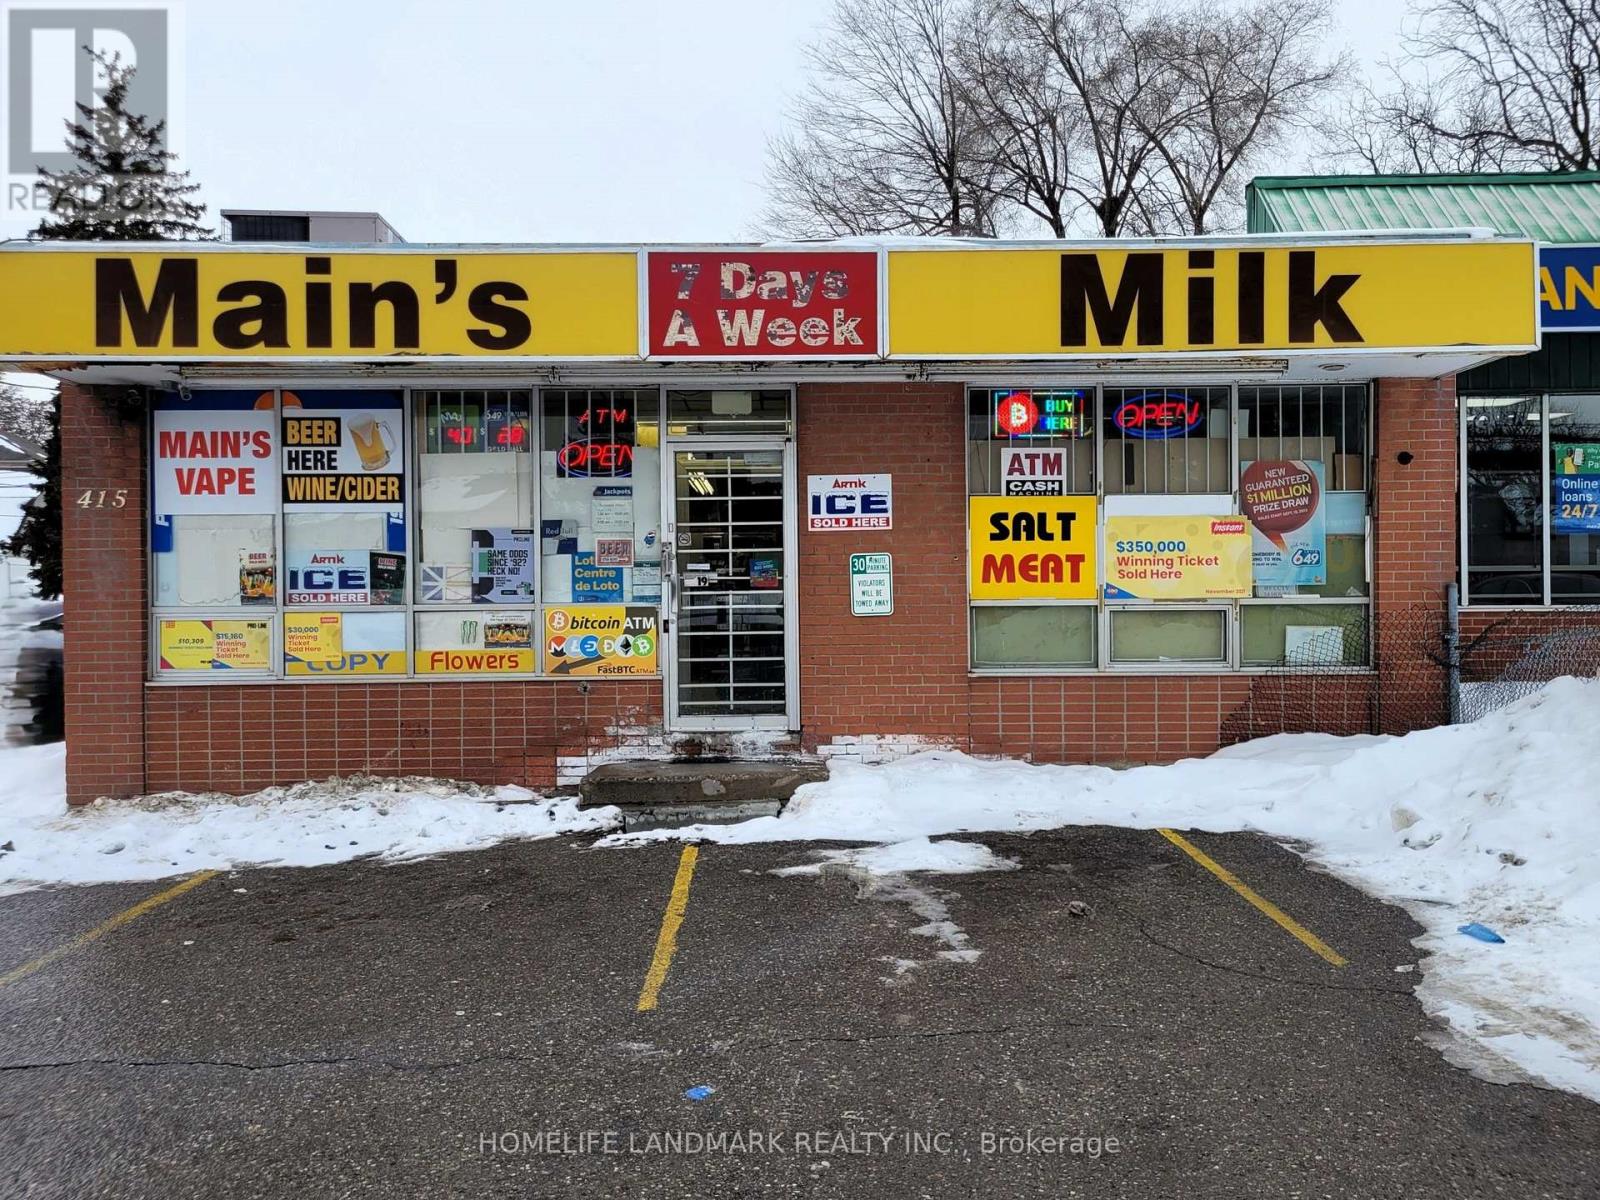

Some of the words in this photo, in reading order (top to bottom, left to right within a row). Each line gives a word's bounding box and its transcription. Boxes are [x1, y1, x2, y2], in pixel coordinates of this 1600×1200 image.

[670, 263, 701, 301] 7
[720, 262, 849, 308] Days
[95, 257, 531, 351] Main's
[1060, 250, 1364, 347] Milk
[663, 309, 700, 347] A
[716, 308, 864, 347] Week
[1045, 399, 1073, 413] BUY
[1117, 402, 1199, 427] OPEN
[577, 408, 628, 424] ATM
[286, 420, 337, 445] BEER
[159, 431, 272, 459] MAIN'S
[287, 450, 338, 471] HERE
[560, 444, 635, 467] OPEN
[1007, 453, 1062, 475] ATM
[174, 467, 256, 495] VAPE
[1264, 467, 1286, 478] NEW
[287, 476, 400, 501] WINE/CIDER
[1009, 481, 1060, 491] CASH
[1245, 473, 1309, 492] GUARANTEED
[1561, 479, 1599, 489] Online
[77, 489, 128, 508] 415
[1260, 483, 1312, 503] MILLION
[1561, 491, 1593, 502] loans
[812, 491, 889, 515] ICE
[1252, 501, 1280, 514] PRIZE
[1281, 496, 1309, 509] DRAW
[1561, 504, 1598, 518] 24/7
[813, 518, 849, 528] SOLD
[852, 517, 888, 527] HERE
[989, 511, 1076, 541] SALT
[487, 549, 507, 558] SAME
[1116, 540, 1186, 553] $350,000
[853, 557, 866, 572] 30
[982, 553, 1085, 583] MEAT
[1116, 556, 1175, 569] Winning
[1178, 555, 1219, 566] Ticket
[288, 566, 367, 590] ICE
[574, 568, 616, 578] Centre
[696, 576, 708, 586] 19
[1118, 568, 1147, 579] Sold
[1150, 568, 1182, 579] Here
[575, 582, 590, 591] de
[593, 581, 620, 591] Loto
[857, 579, 886, 587] VIOLATORS
[291, 593, 326, 602] SOLD
[330, 593, 366, 602] HERE
[570, 615, 620, 630] bitcoin
[623, 616, 655, 629] ATM
[216, 640, 247, 648] Winning
[430, 651, 519, 670] Flowers
